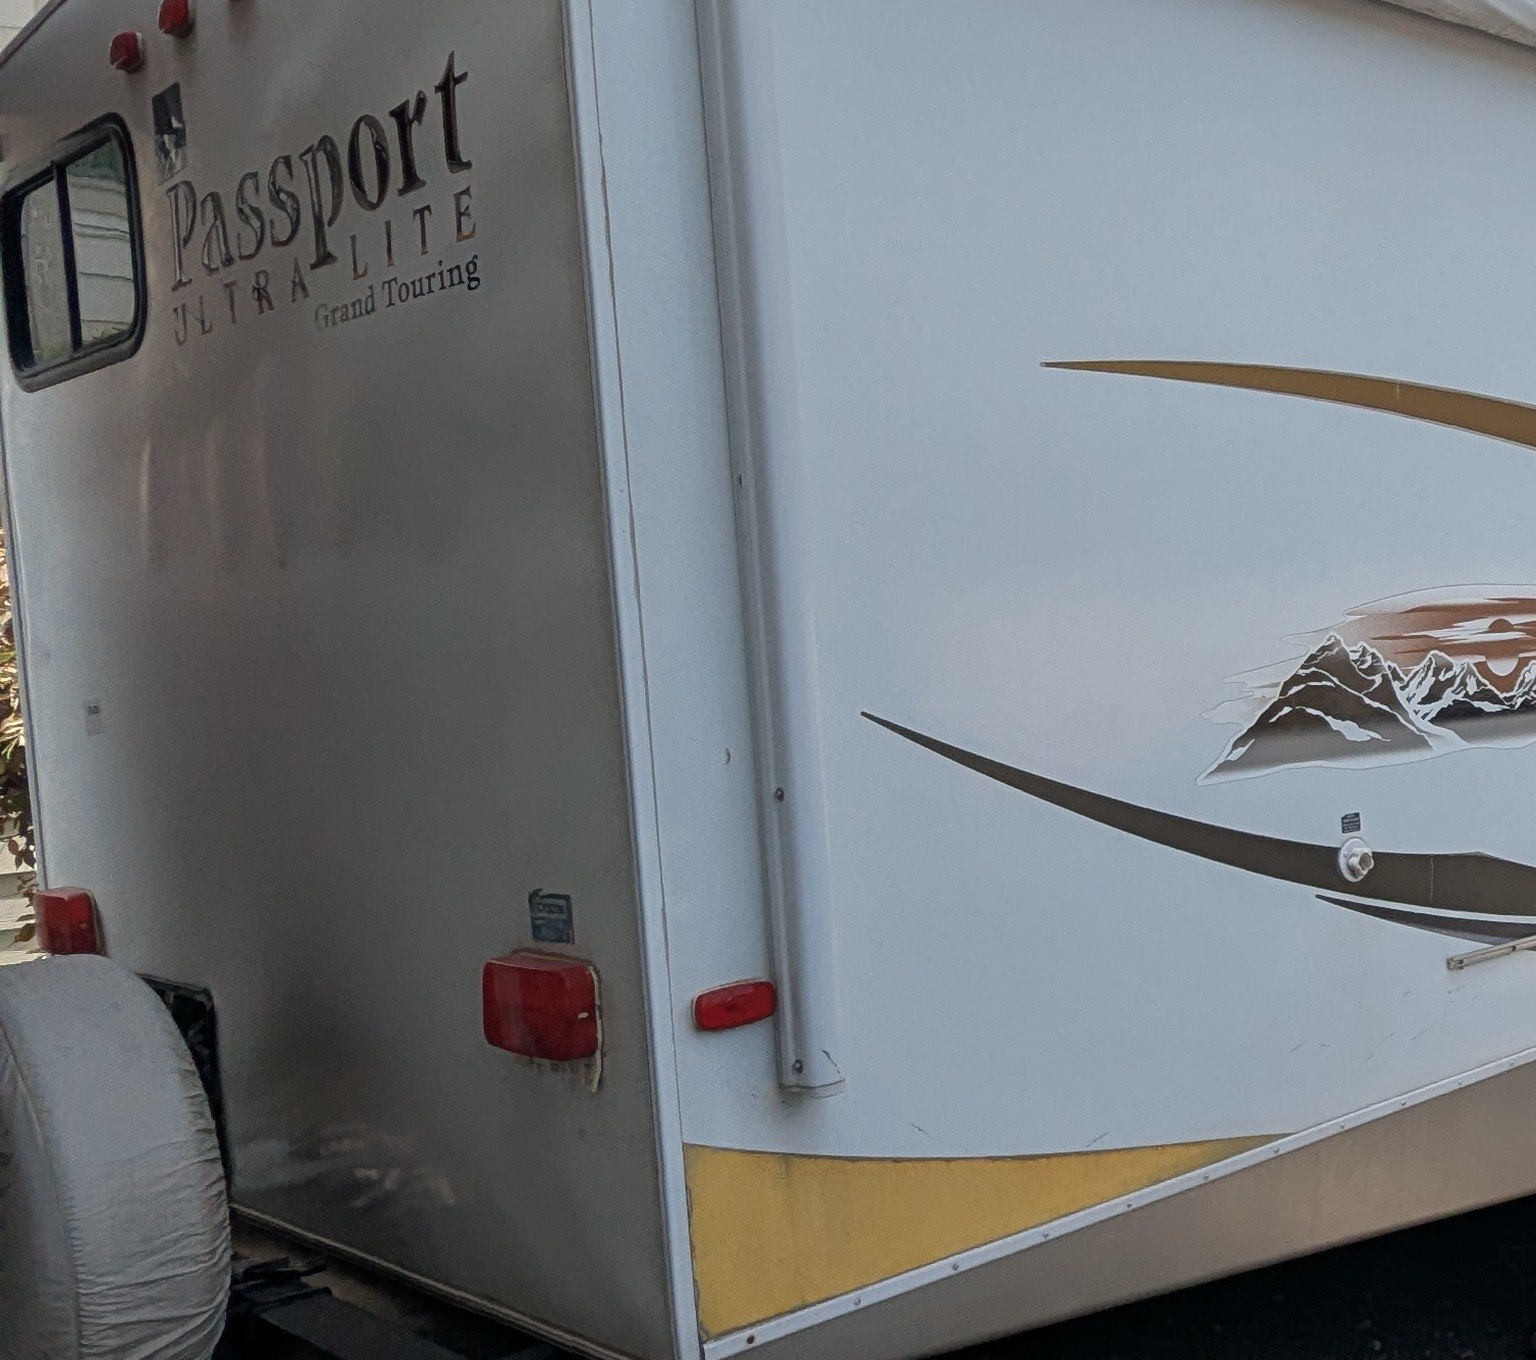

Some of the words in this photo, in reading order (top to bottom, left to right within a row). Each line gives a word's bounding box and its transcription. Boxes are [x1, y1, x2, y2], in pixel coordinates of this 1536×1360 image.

[165, 51, 473, 292] Passport
[172, 257, 310, 347] ULTRA
[350, 186, 478, 281] LITE
[313, 284, 376, 331] Grand
[382, 254, 481, 308] Touring
